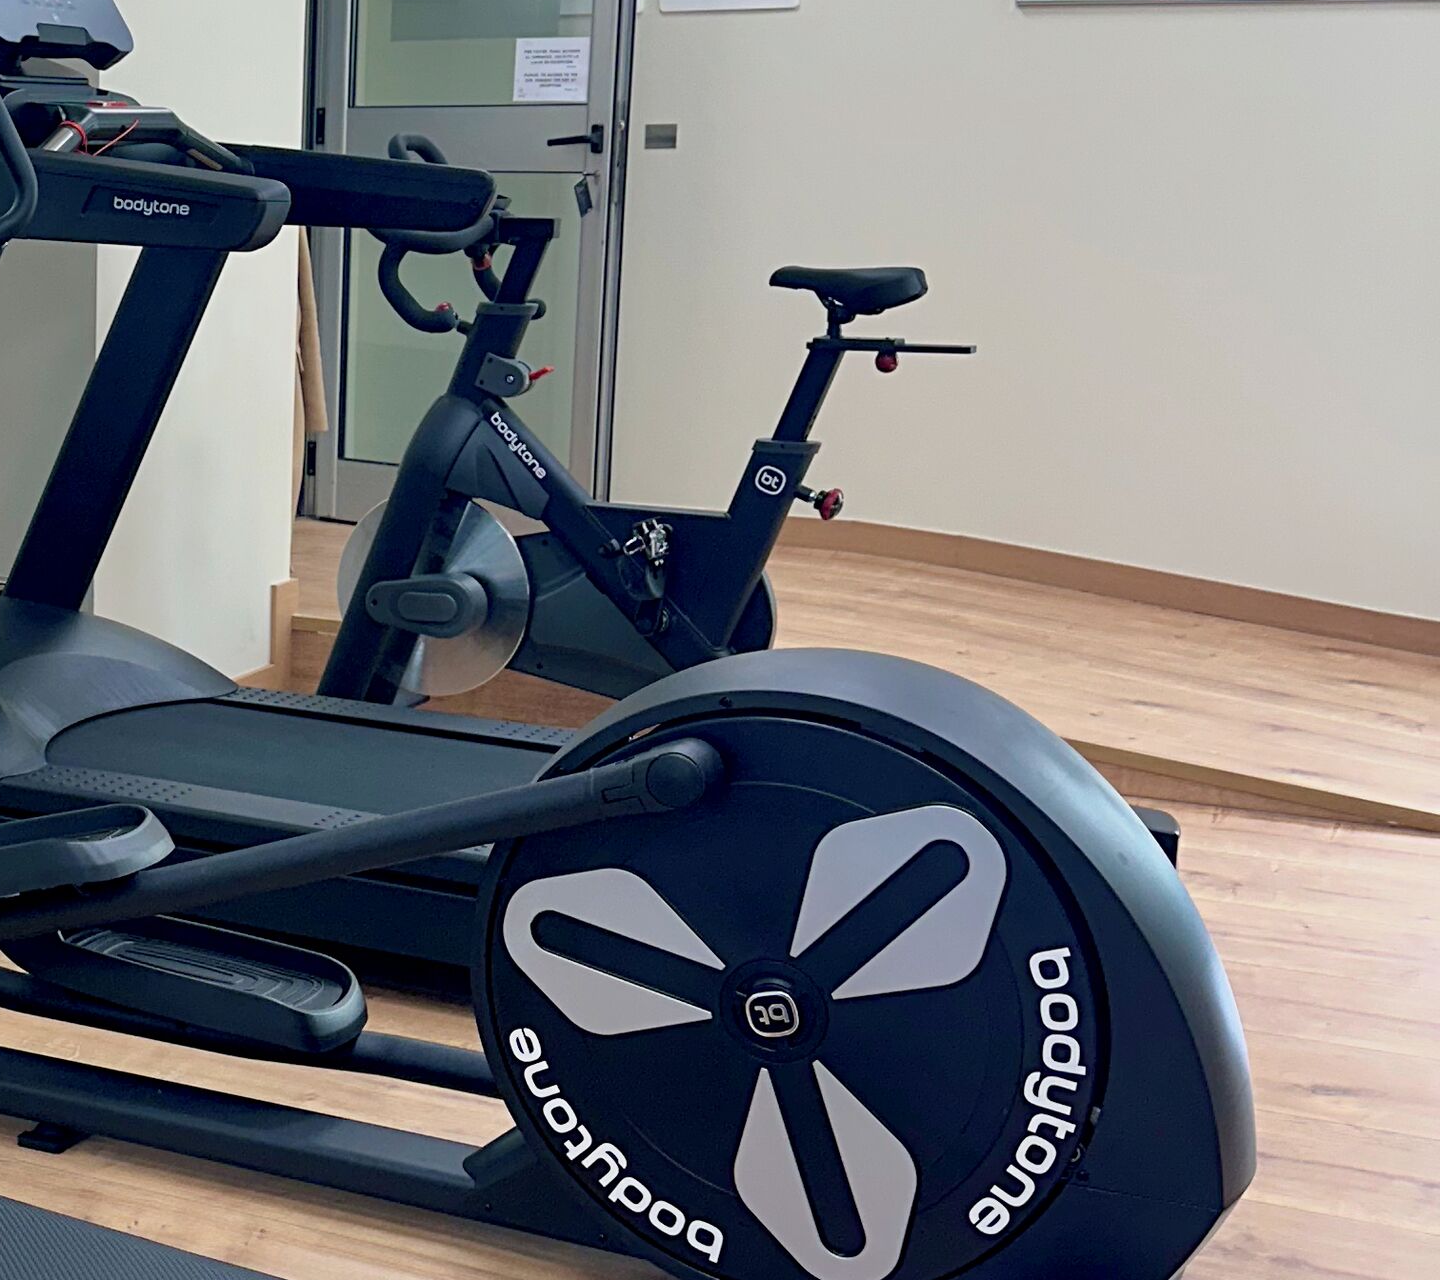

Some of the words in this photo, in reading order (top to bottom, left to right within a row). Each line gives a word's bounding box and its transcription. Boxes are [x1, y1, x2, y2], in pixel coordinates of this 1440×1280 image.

[112, 195, 191, 218] bodytone
[489, 410, 548, 480] bodytone
[508, 1026, 725, 1264] bodytone
[969, 946, 1096, 1237] bodytone
